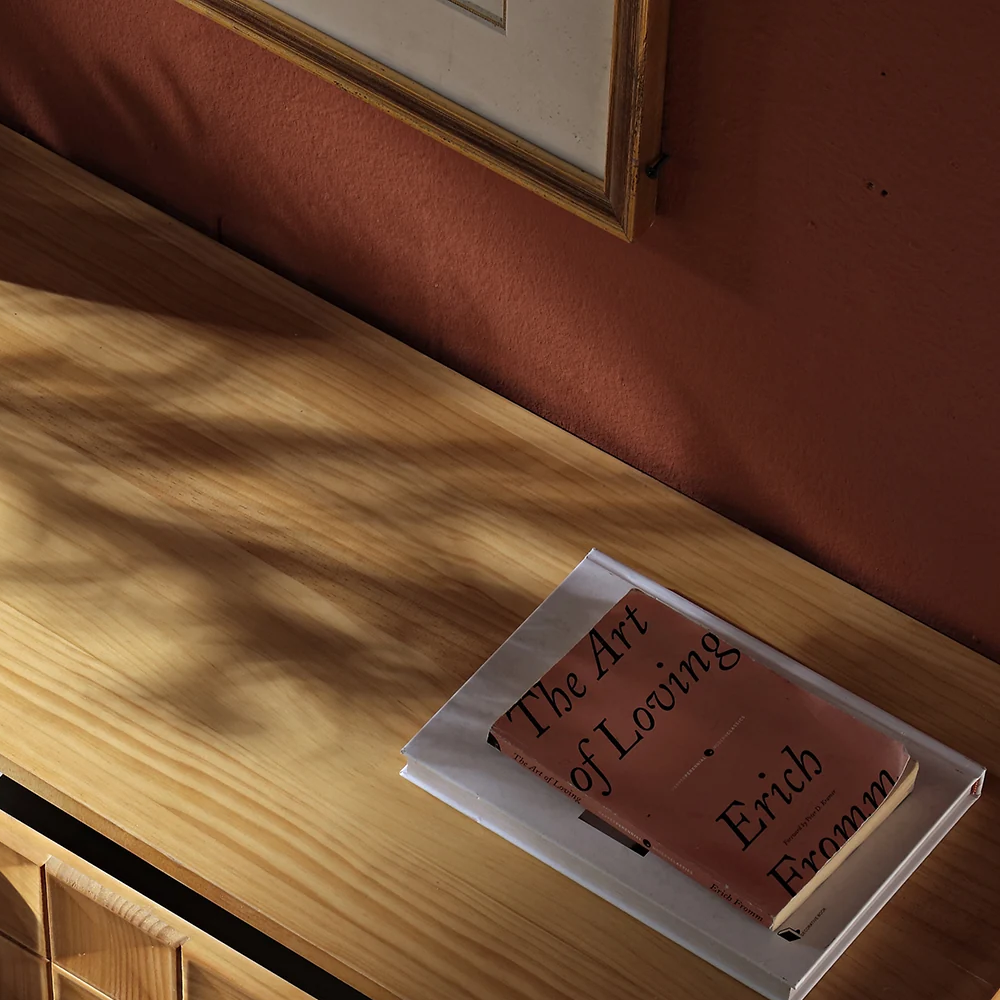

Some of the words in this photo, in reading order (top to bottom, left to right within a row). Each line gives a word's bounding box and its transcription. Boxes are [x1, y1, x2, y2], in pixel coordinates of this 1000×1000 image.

[505, 672, 587, 738] The
[589, 604, 648, 681] Art
[570, 738, 612, 796] of
[593, 632, 741, 760] Loving
[514, 753, 527, 766] The
[529, 766, 543, 776] Art
[553, 780, 581, 804] Loving
[715, 745, 822, 851] Erich
[766, 769, 899, 897] Fromm
[710, 883, 732, 902] Erich
[734, 899, 763, 921] Fromm
